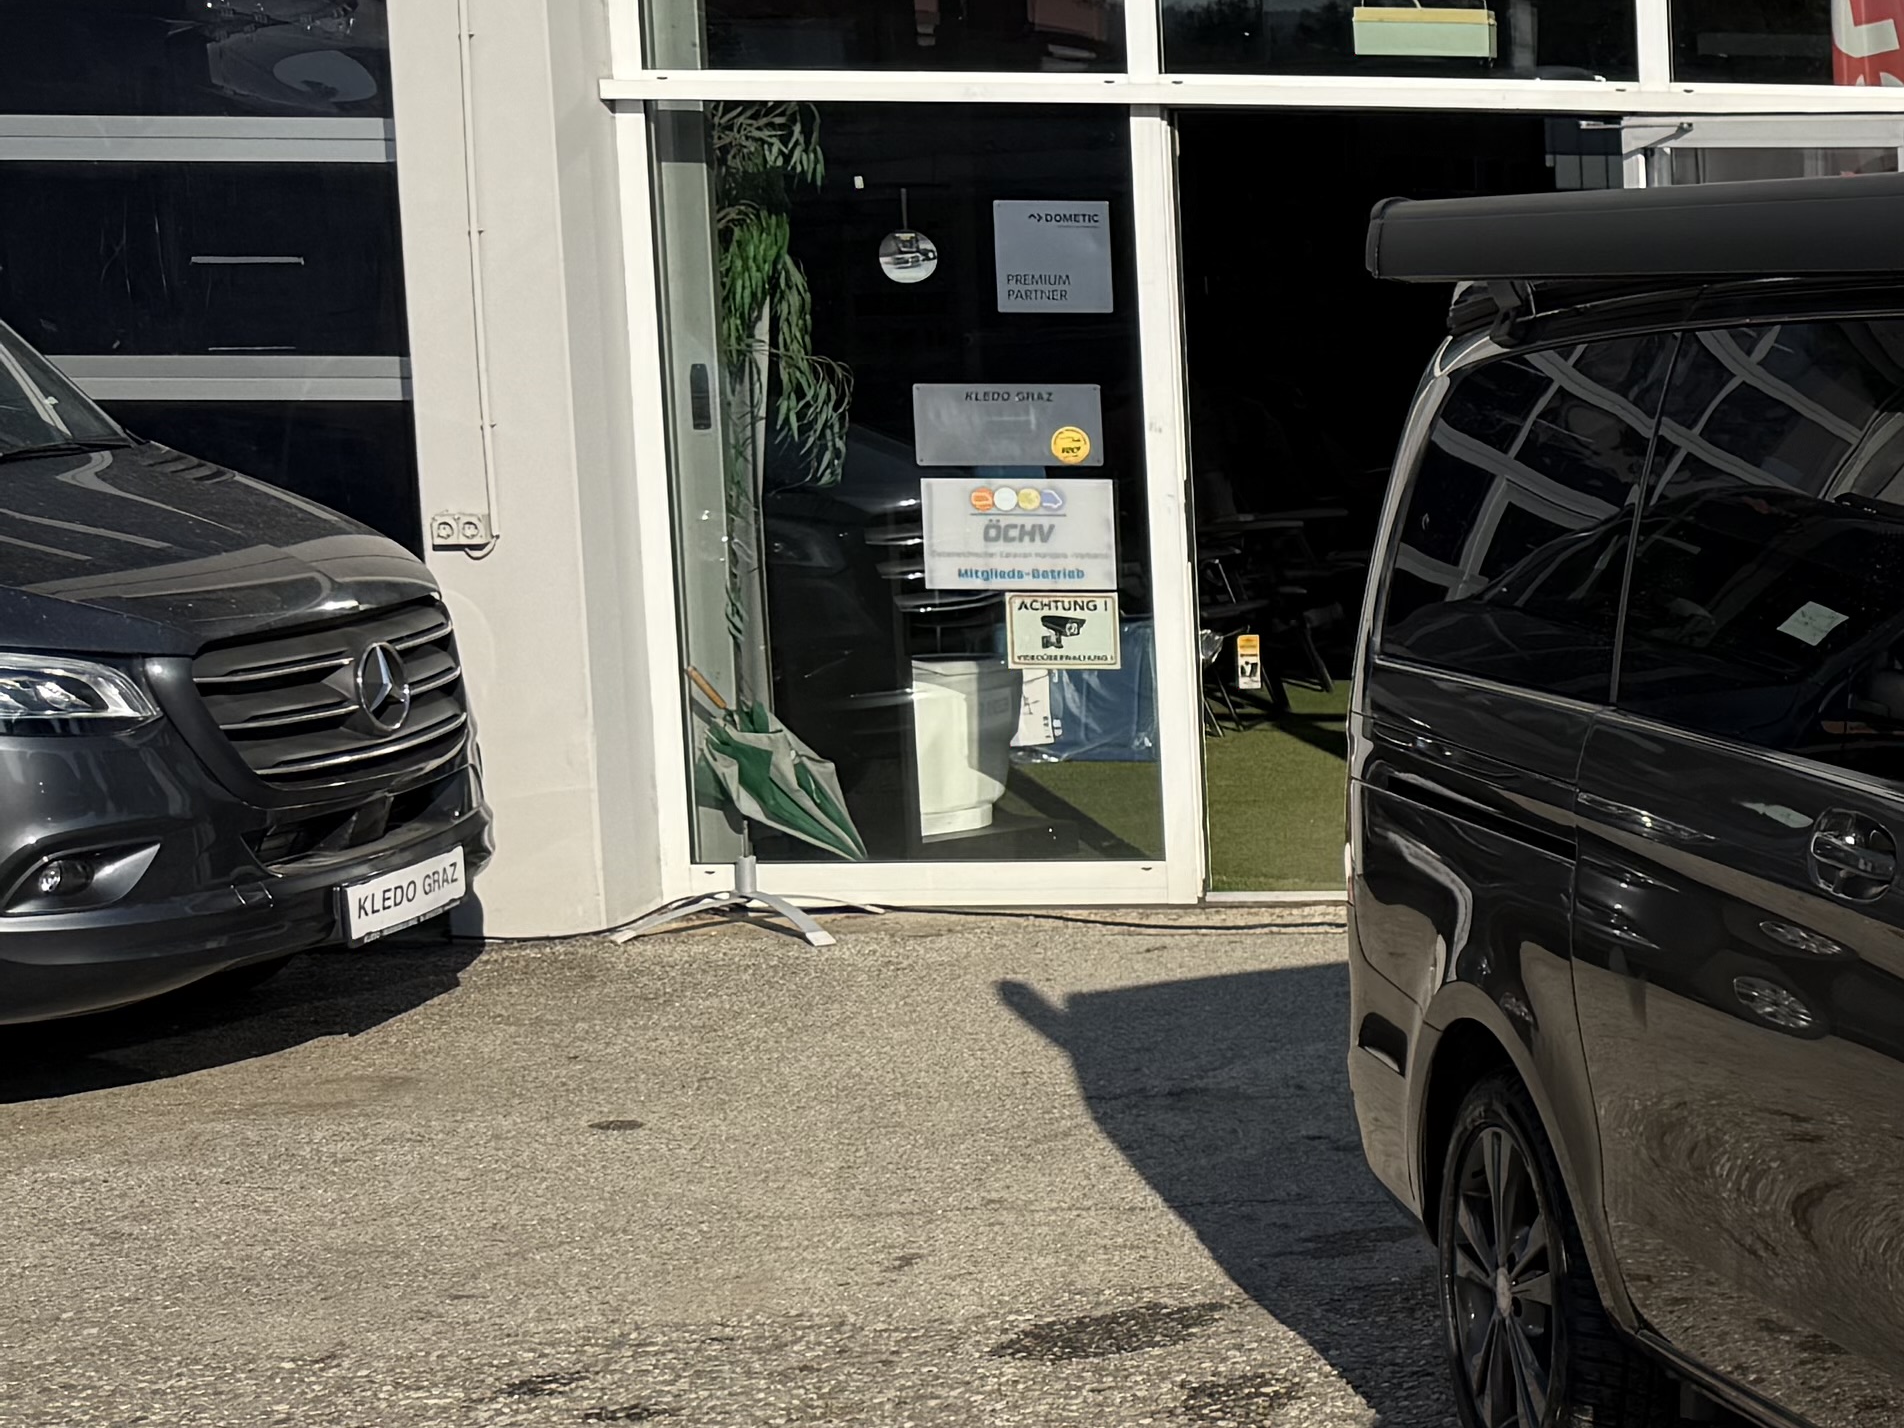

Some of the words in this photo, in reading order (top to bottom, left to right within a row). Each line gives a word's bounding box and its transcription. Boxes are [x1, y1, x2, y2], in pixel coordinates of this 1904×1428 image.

[1044, 213, 1100, 223] DOMETIC
[1006, 274, 1071, 286] PREMIUM
[1007, 289, 1068, 301] PARTNER
[965, 391, 1011, 402] KLEDO
[1016, 391, 1054, 403] GRAZ
[983, 519, 1056, 544] ÖCHV
[1017, 599, 1098, 612] ACHTUNG
[358, 880, 417, 920] KLEDO
[422, 861, 458, 896] GRAZ
